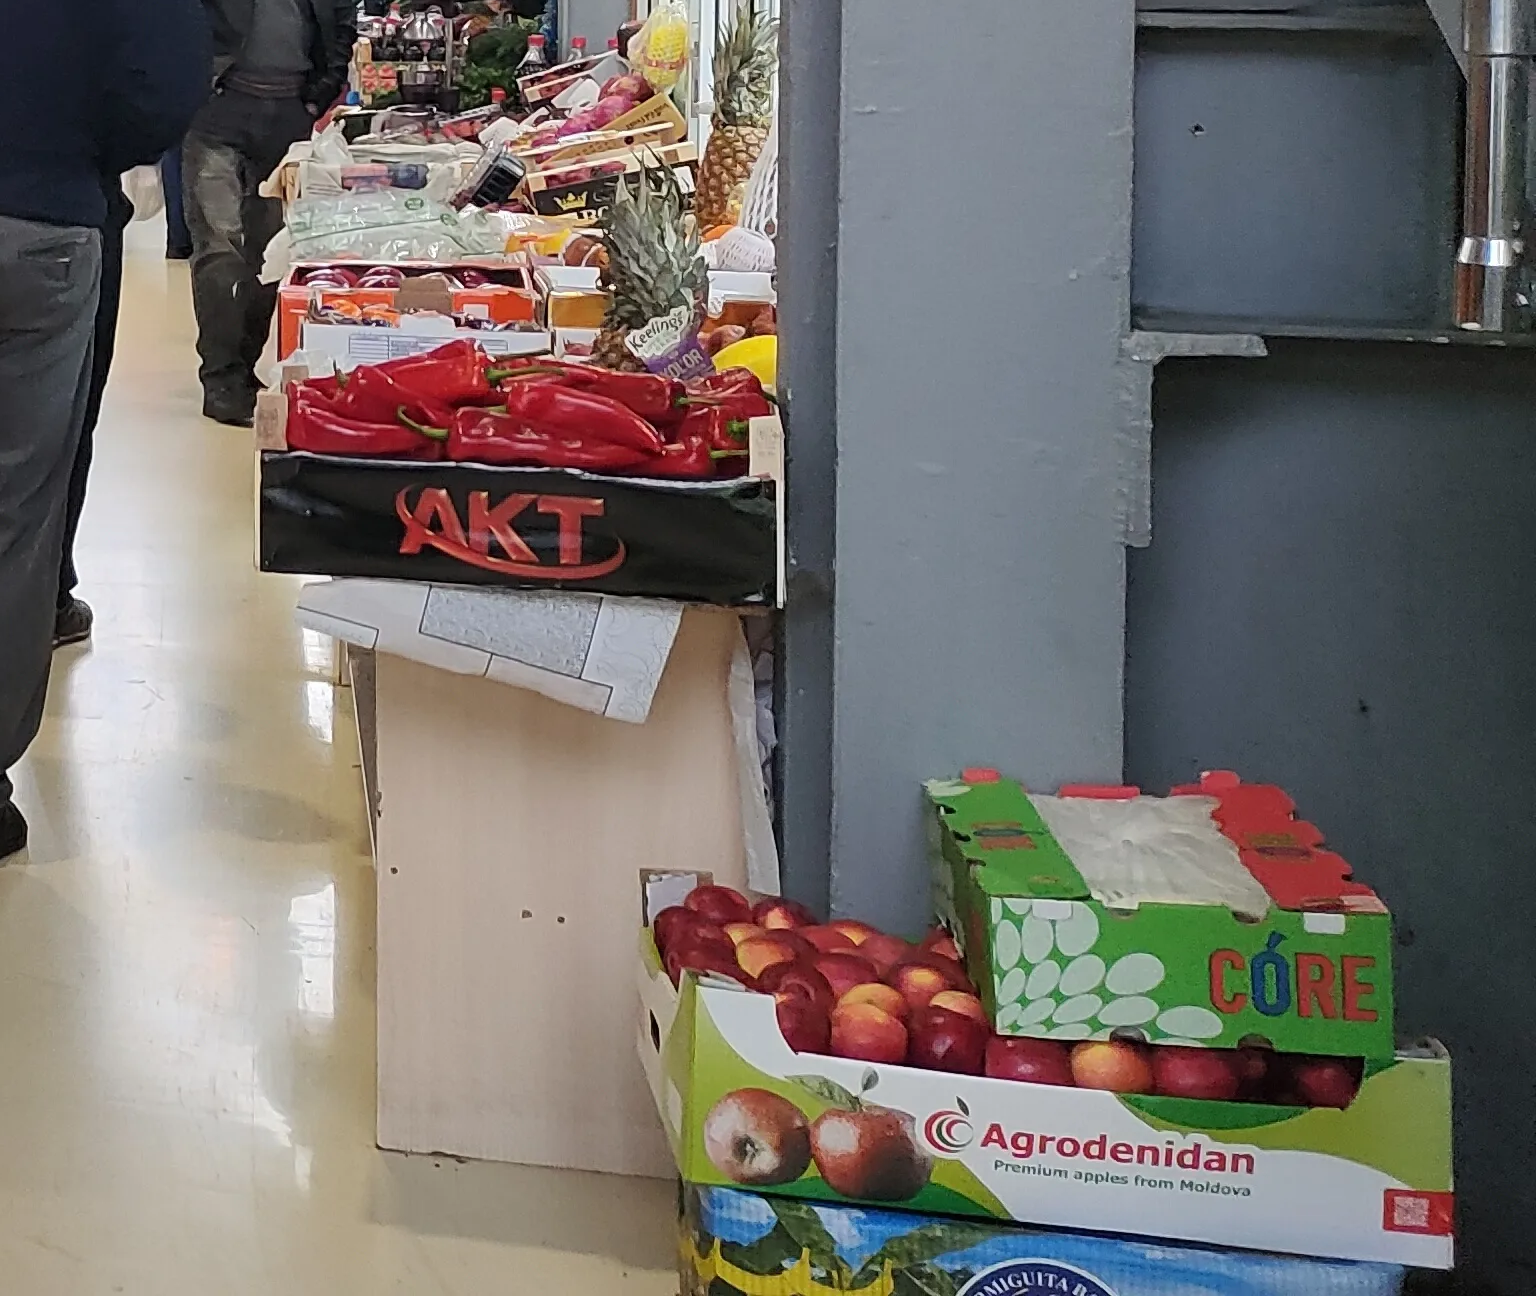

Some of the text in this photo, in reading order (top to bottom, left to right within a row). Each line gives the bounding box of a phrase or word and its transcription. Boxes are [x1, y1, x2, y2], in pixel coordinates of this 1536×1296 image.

[628, 310, 685, 353] Keelings
[399, 487, 606, 566] AKT
[980, 1122, 1255, 1175] Agrodenidan
[994, 1159, 1251, 1198] Premium apples from Moldova
